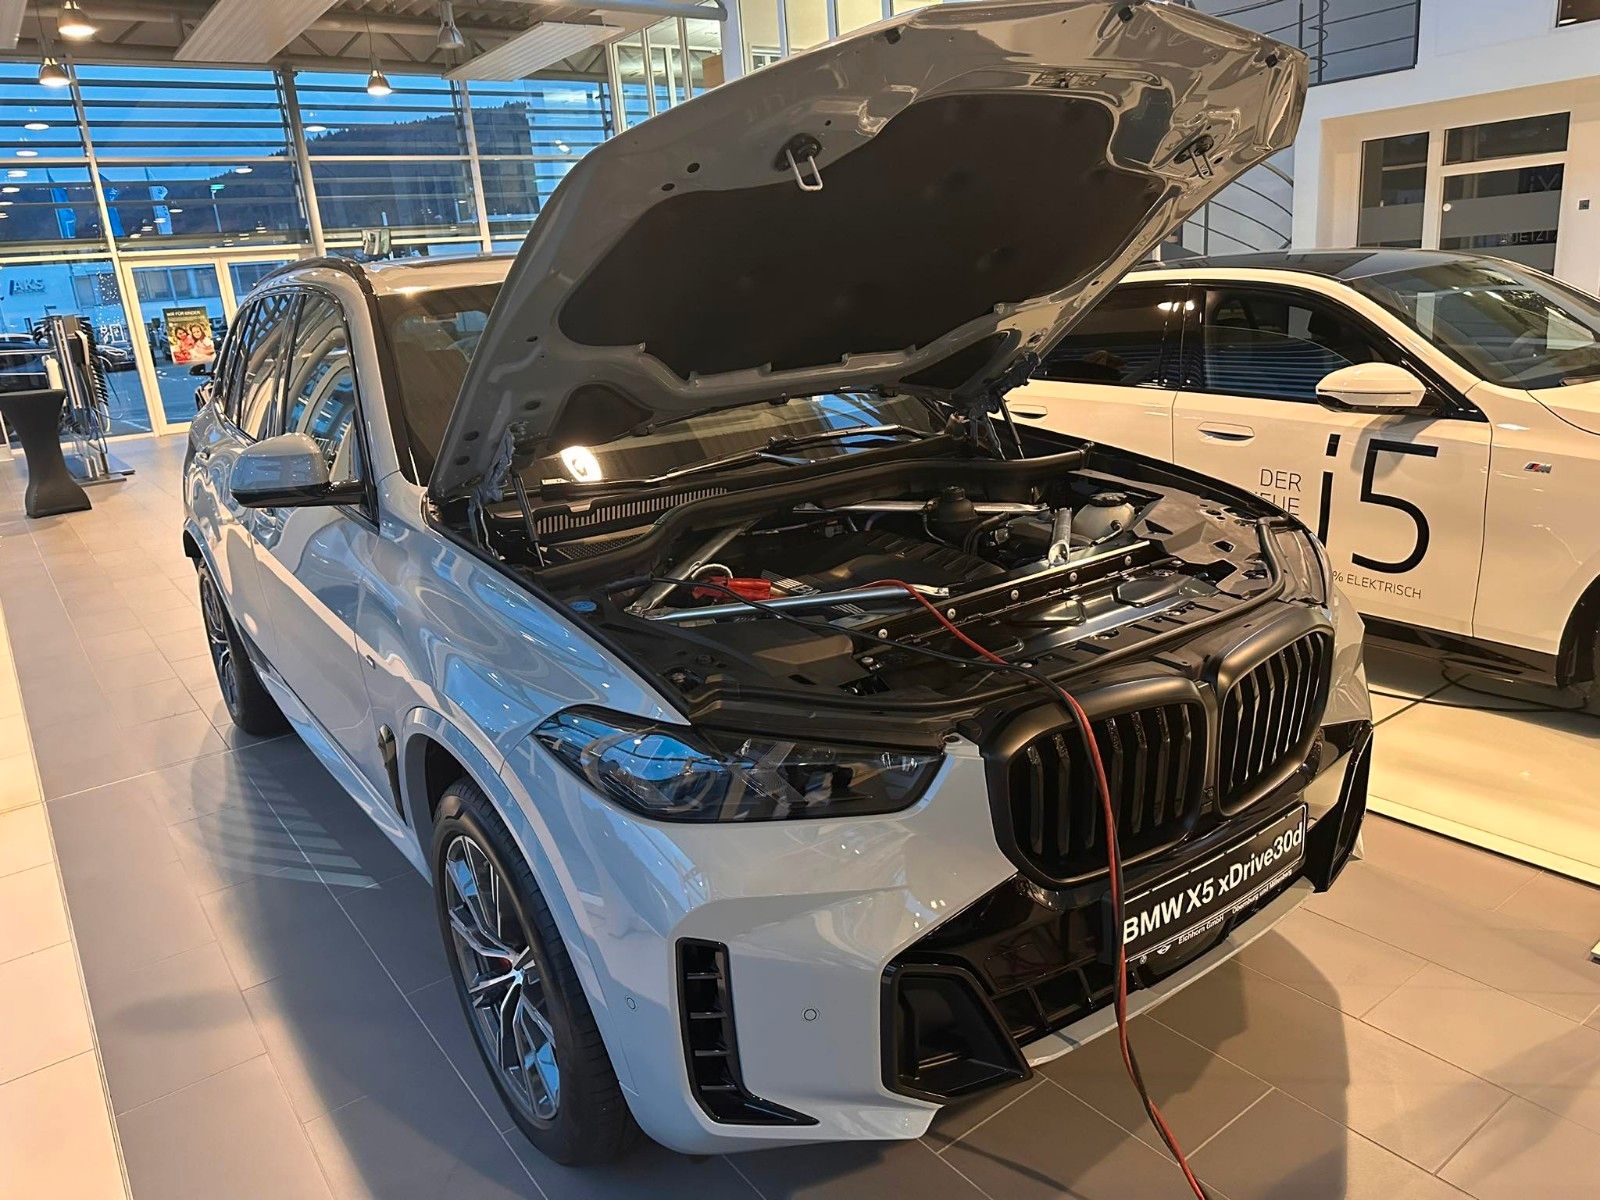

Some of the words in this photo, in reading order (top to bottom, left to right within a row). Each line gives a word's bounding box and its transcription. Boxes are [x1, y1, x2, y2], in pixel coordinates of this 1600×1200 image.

[1260, 469, 1301, 492] DER
[1317, 434, 1439, 573] i5
[1346, 573, 1422, 599] ELEKTRISCH
[1122, 892, 1184, 945] BMW
[1186, 878, 1214, 916] X5
[1218, 823, 1304, 897] xDrive30d
